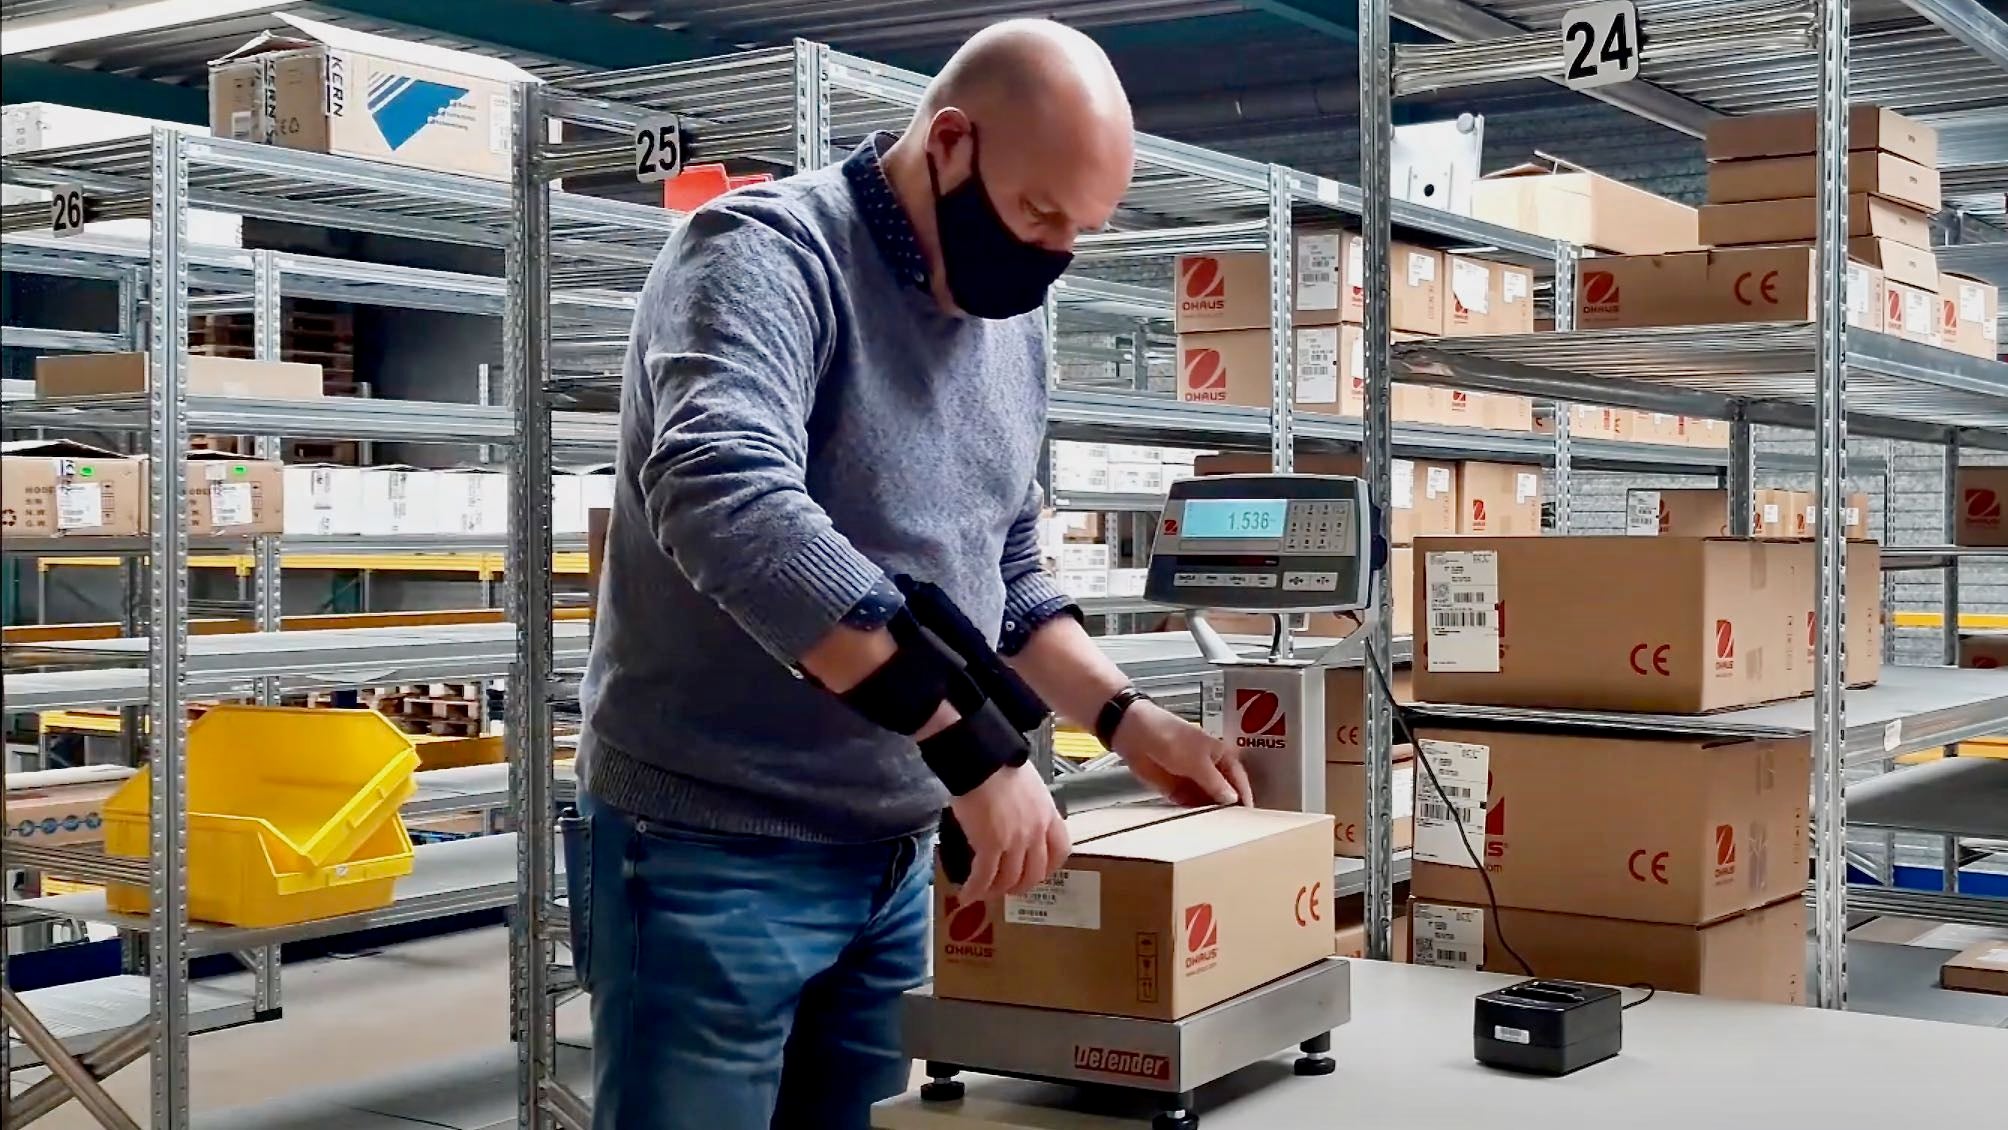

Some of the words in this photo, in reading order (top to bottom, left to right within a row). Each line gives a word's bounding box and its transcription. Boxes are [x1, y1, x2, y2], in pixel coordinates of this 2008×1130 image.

[1566, 12, 1633, 80] 24
[331, 55, 344, 117] KERN
[637, 125, 677, 174] 25
[53, 191, 80, 231] 26
[1734, 270, 1778, 306] CE
[1182, 300, 1225, 311] OHAUS
[1583, 304, 1620, 314] OHAUS
[1185, 391, 1226, 401] OHAUS
[1228, 511, 1270, 530] 1.536
[1630, 643, 1670, 676] CE
[1236, 737, 1286, 749] OHAUS
[1337, 725, 1359, 745] CE
[1628, 849, 1669, 885] CE
[1295, 881, 1320, 927] CE
[944, 943, 994, 958] OHAUS
[1185, 948, 1218, 968] OHAUS
[1075, 1045, 1166, 1078] Defender
